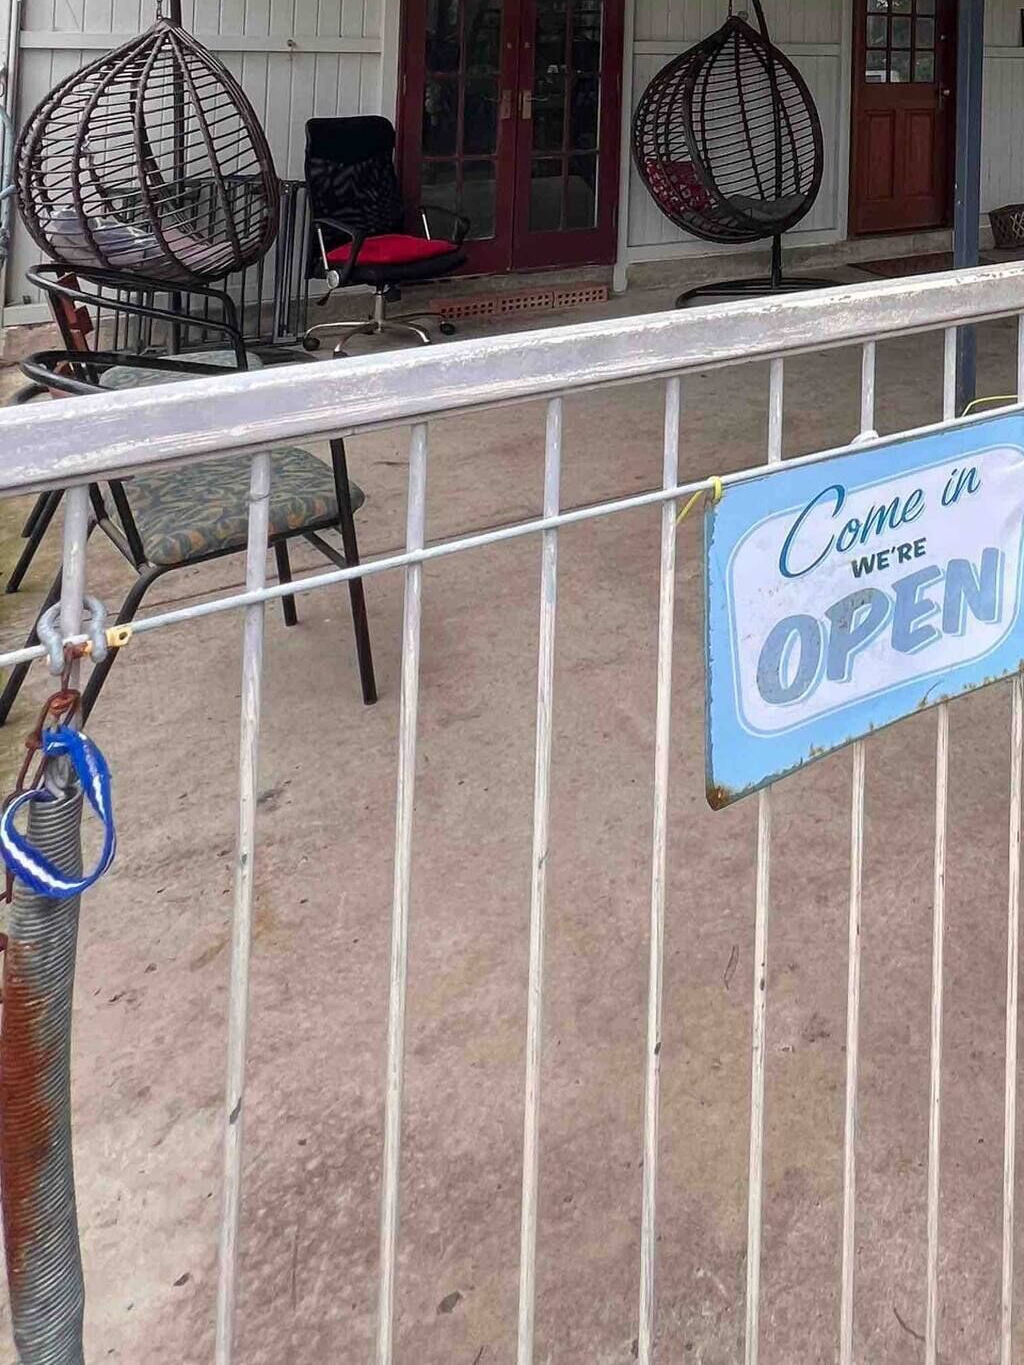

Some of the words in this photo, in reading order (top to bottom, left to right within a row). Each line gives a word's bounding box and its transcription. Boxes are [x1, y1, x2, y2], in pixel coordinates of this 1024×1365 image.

[779, 484, 925, 579] Come
[941, 466, 981, 508] in
[851, 537, 926, 579] WE'RE
[756, 547, 1006, 707] OPEN
